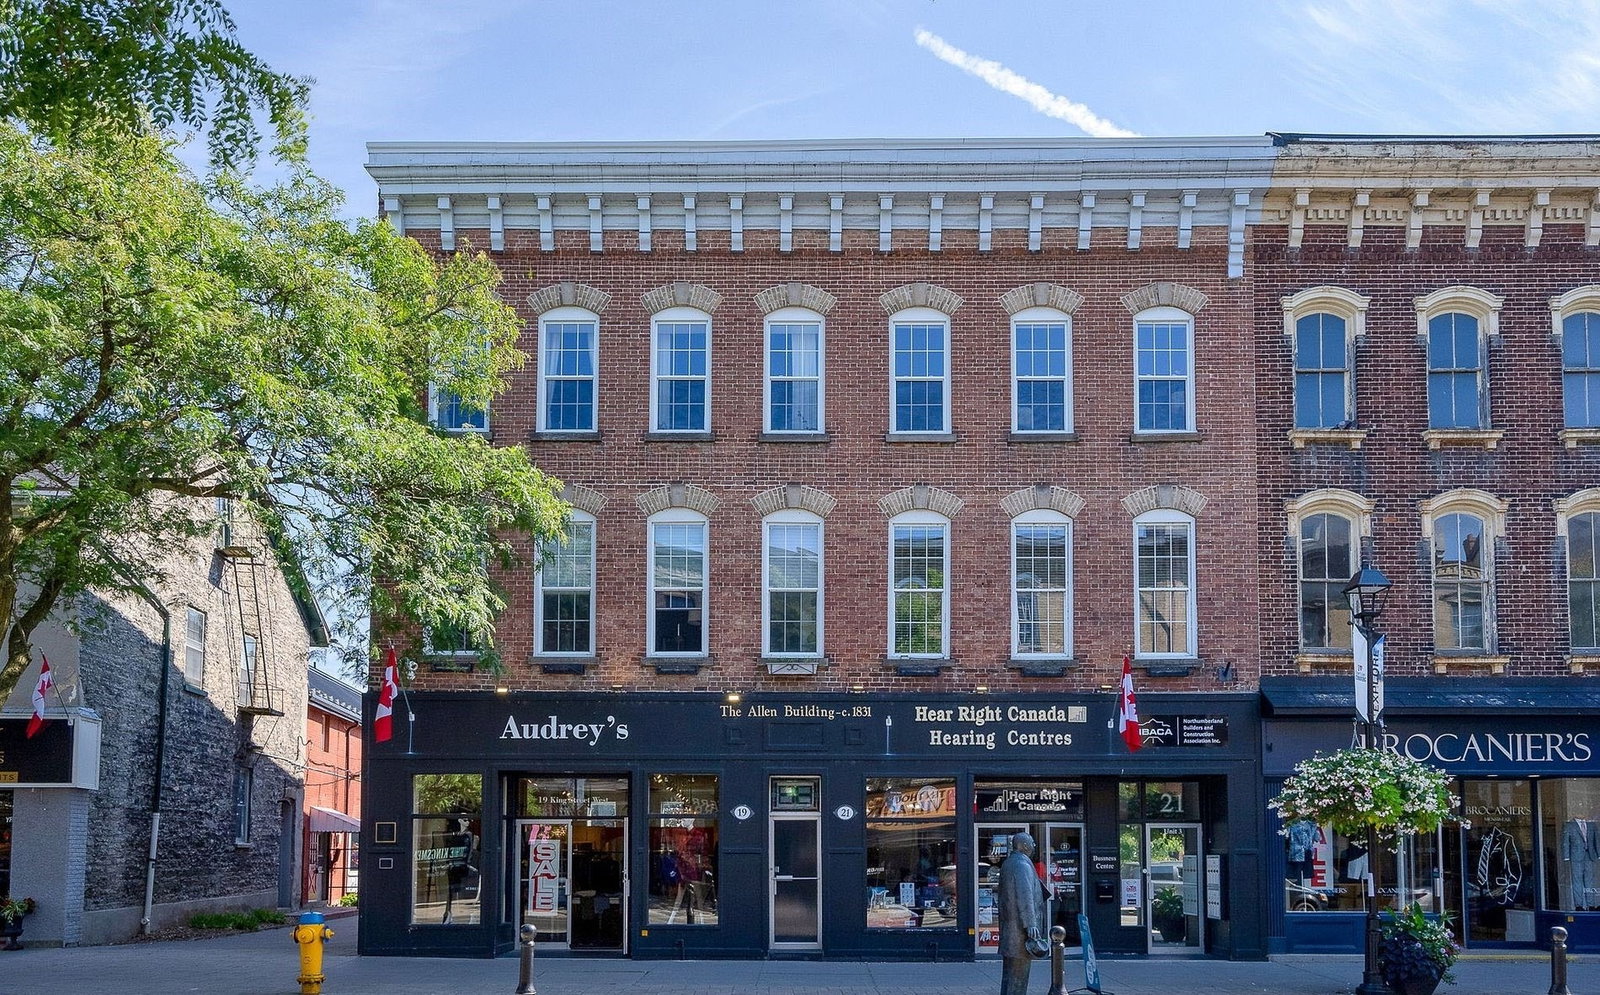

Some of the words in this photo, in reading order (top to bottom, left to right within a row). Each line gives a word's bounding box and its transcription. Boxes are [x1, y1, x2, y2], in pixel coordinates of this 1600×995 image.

[720, 705, 742, 717] The
[748, 705, 777, 717] Allen
[915, 706, 953, 722] Hear
[958, 706, 1002, 726] Right
[1007, 706, 1067, 722] Canada
[499, 715, 629, 746] Audrey's
[930, 730, 996, 750] Hearing
[1007, 730, 1072, 746] Centres
[538, 796, 548, 804] 19
[550, 796, 567, 805] King
[1009, 791, 1037, 800] Hear
[1040, 790, 1072, 801] Right
[1018, 802, 1063, 811] Canada
[1160, 793, 1184, 813] 21
[737, 807, 748, 817] 19
[841, 807, 850, 818] 21
[531, 842, 558, 912] SALE
